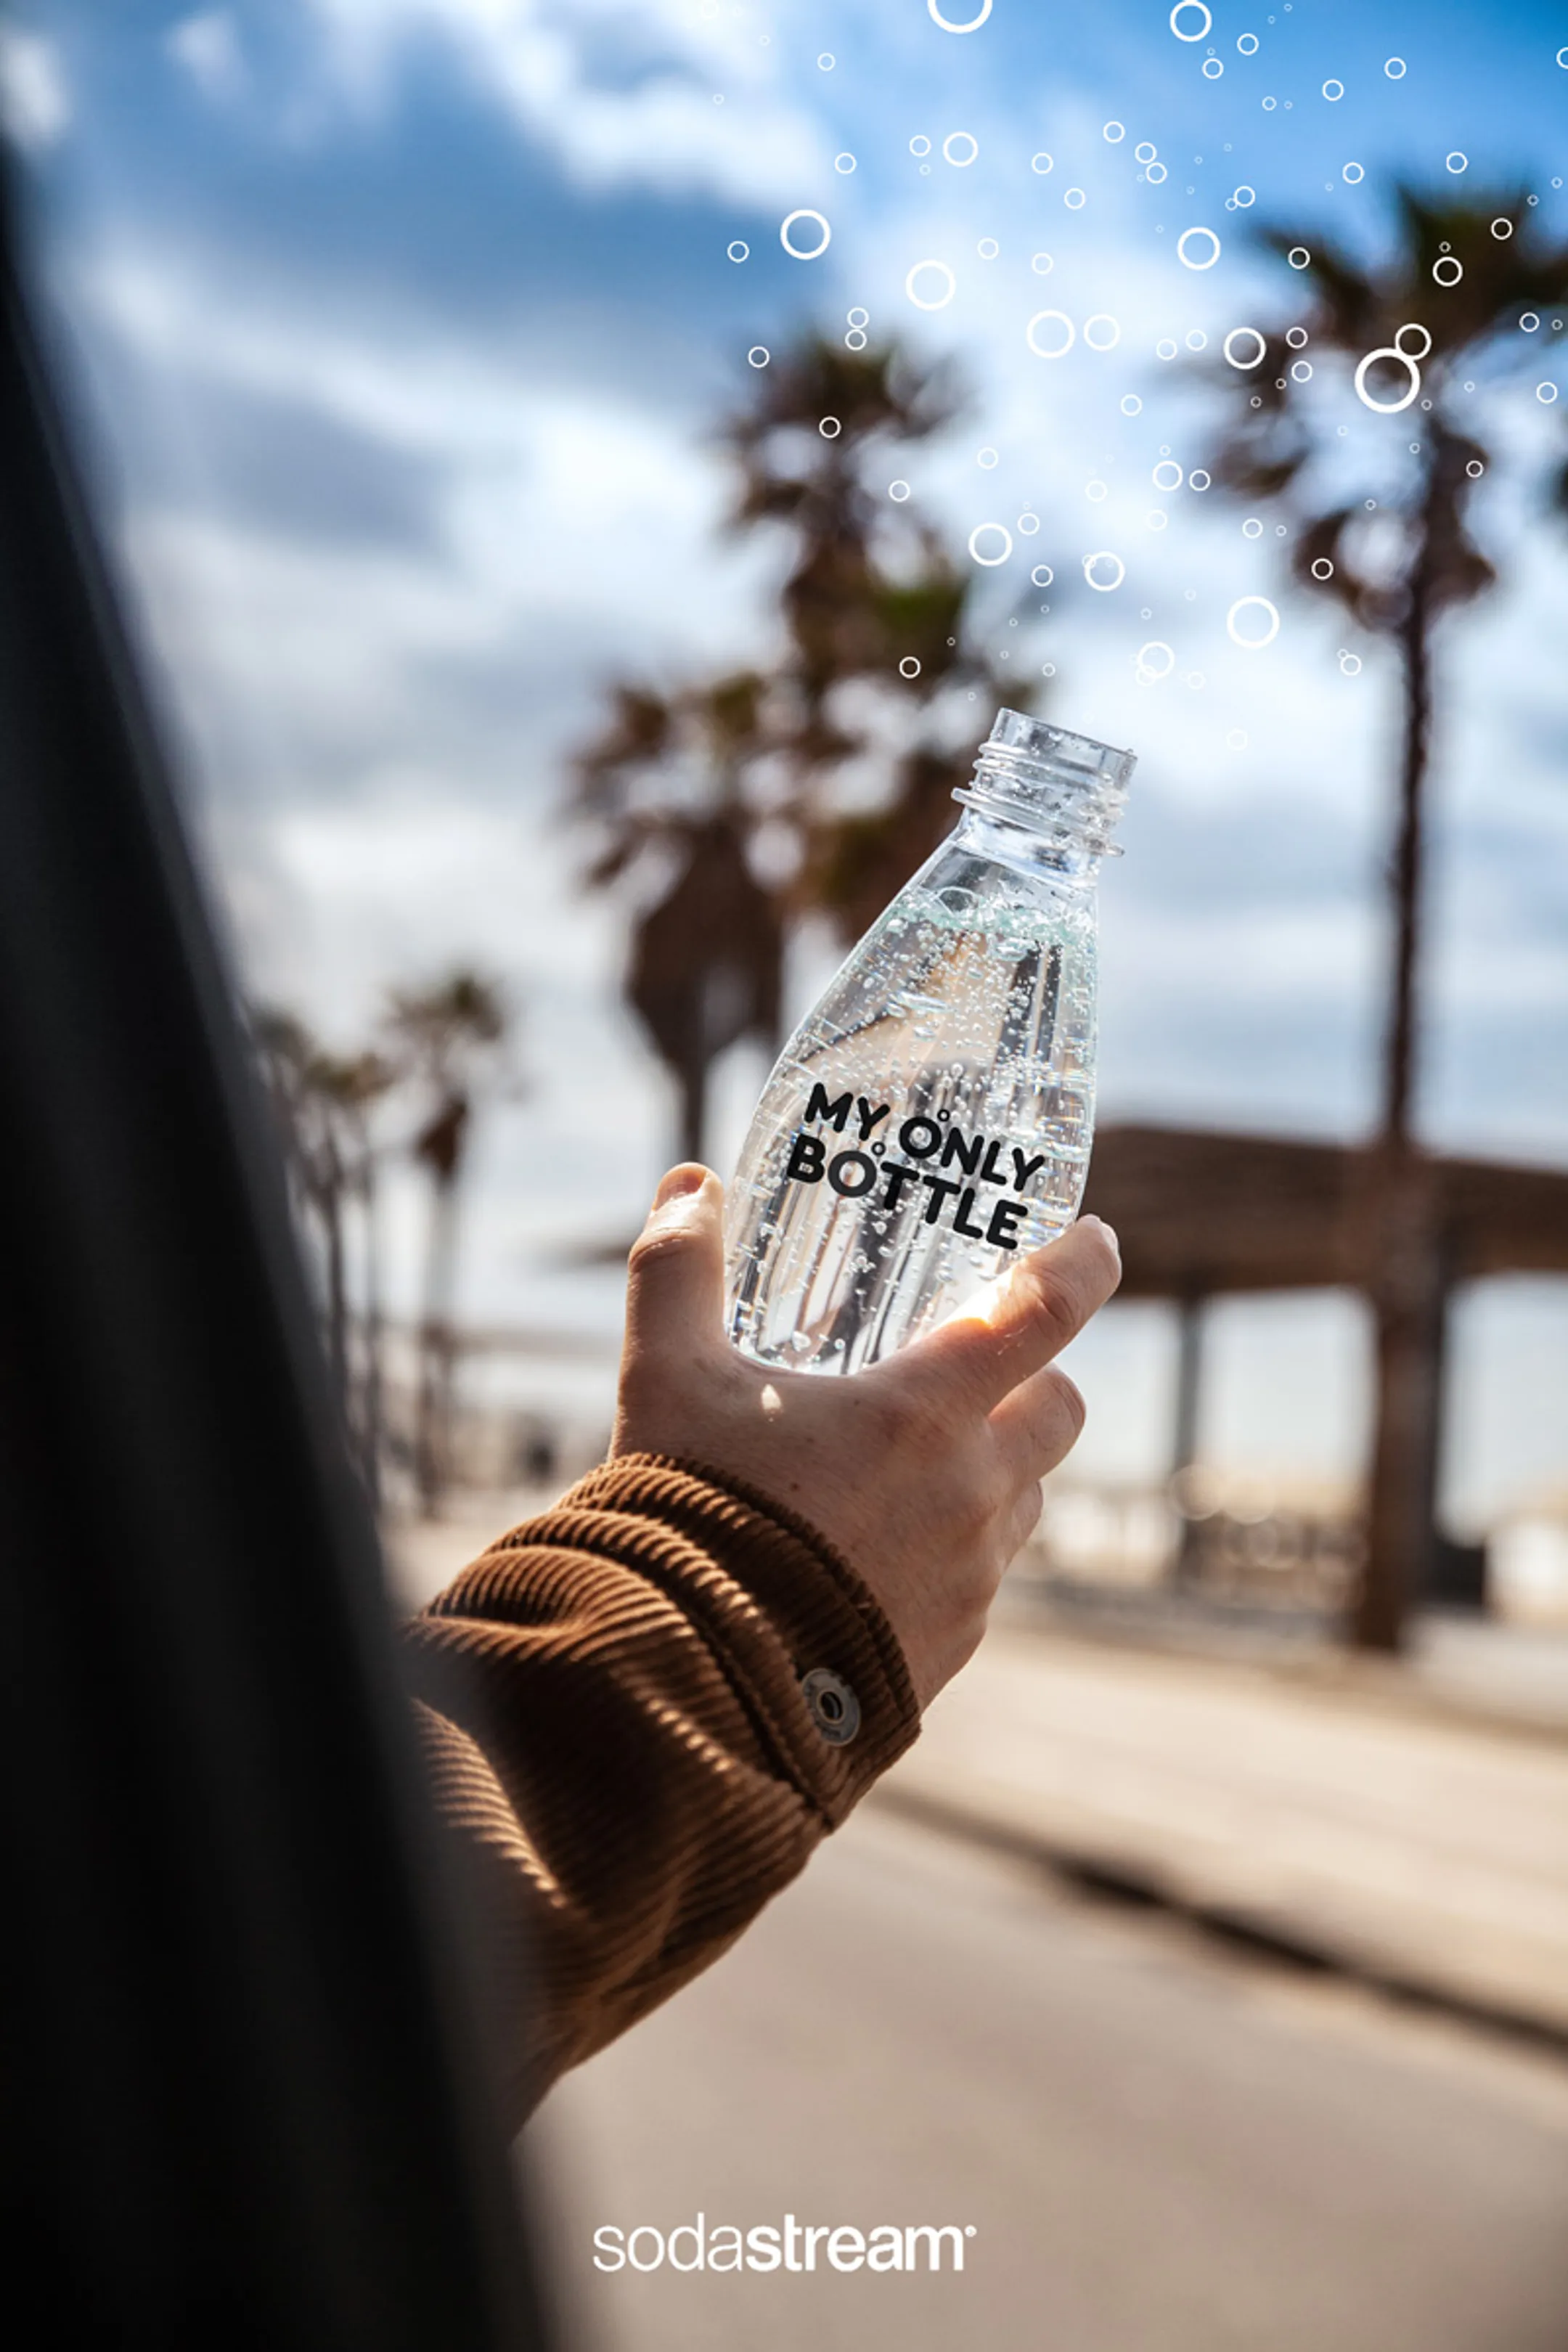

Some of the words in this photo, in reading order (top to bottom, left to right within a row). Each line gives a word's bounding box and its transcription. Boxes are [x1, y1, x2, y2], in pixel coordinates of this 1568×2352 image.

[786, 1133, 1029, 1249] BOTTLE
[804, 1082, 891, 1141] MY
[899, 1115, 1045, 1191] ONLY
